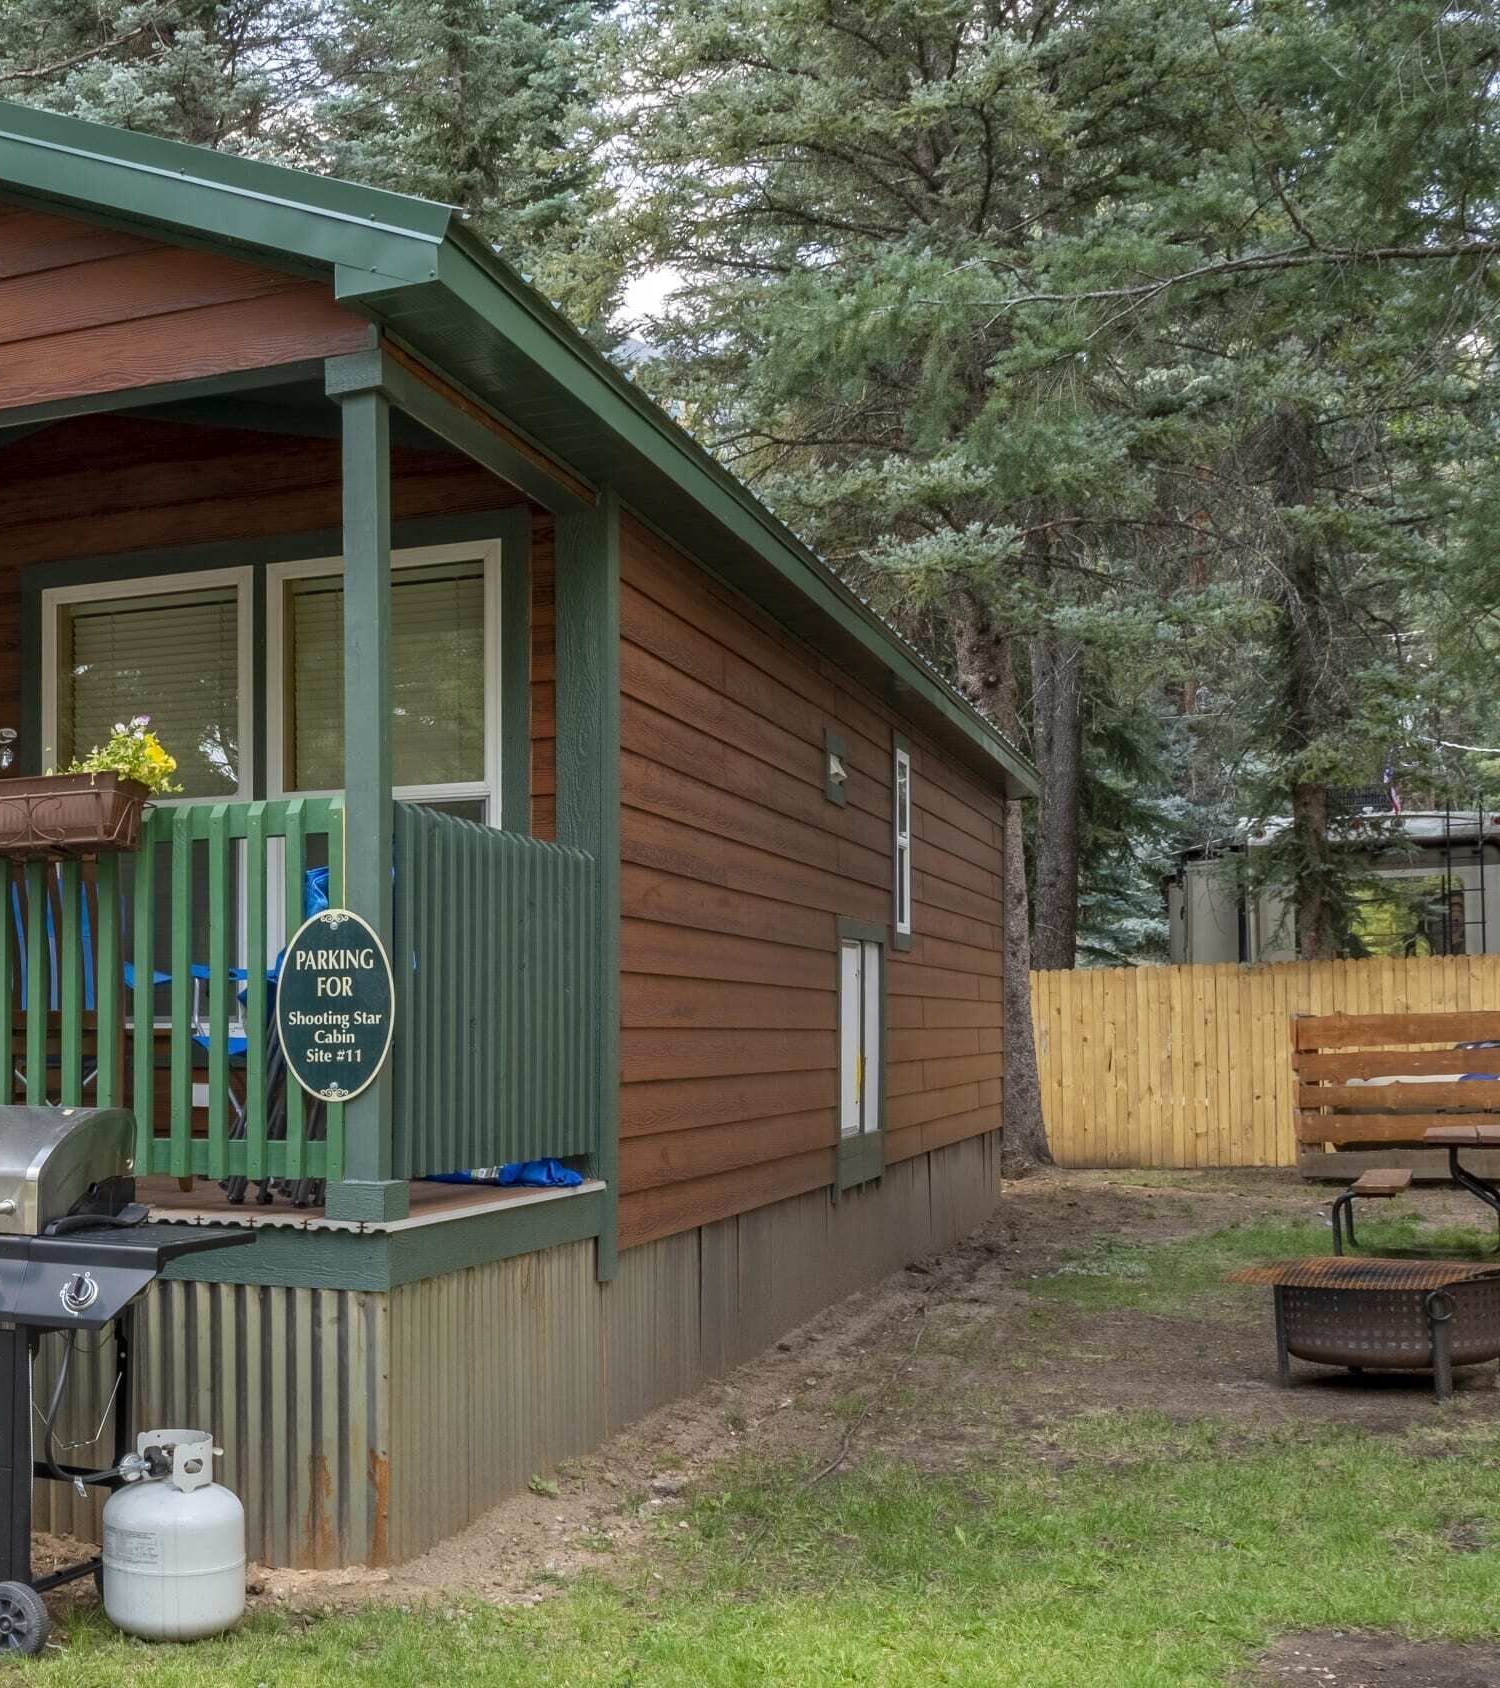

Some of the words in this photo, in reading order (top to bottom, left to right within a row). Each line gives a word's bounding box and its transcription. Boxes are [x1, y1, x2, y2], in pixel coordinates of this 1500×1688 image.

[296, 949, 374, 970] PARKING
[317, 976, 353, 997] FOR
[288, 1011, 350, 1027] Shooting
[354, 1011, 382, 1025] Star
[314, 1030, 355, 1044] Cabin
[306, 1049, 332, 1062] Site
[336, 1050, 361, 1062] #11
